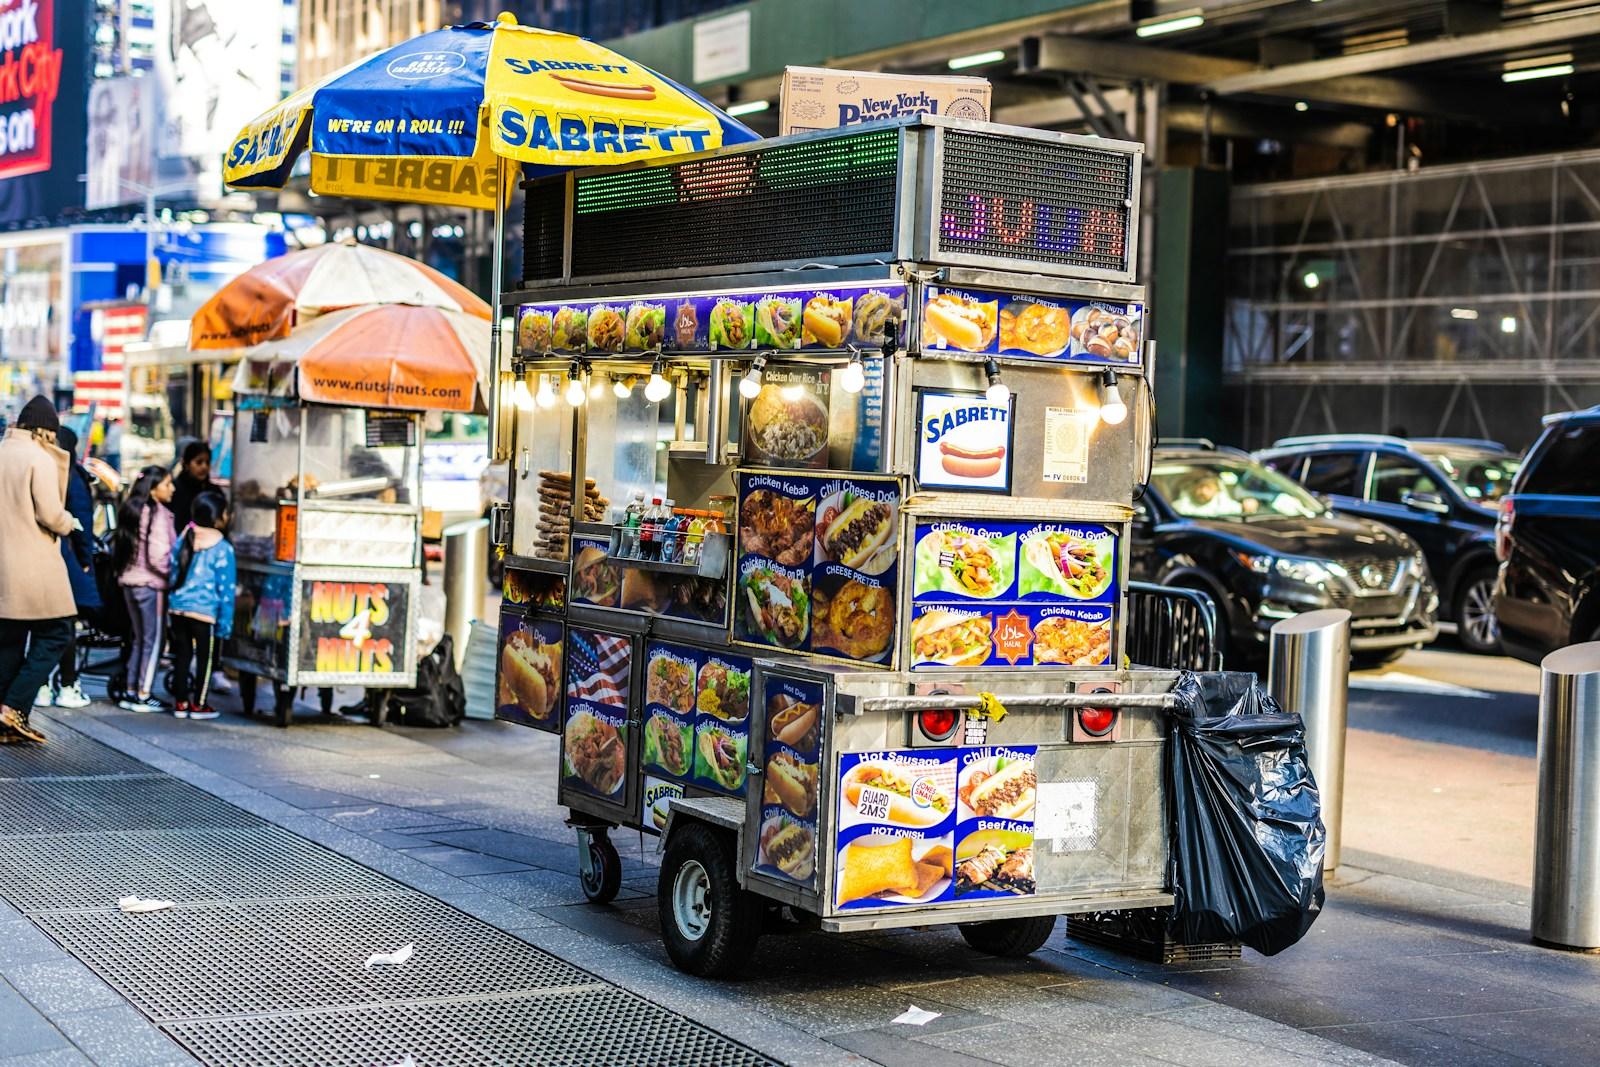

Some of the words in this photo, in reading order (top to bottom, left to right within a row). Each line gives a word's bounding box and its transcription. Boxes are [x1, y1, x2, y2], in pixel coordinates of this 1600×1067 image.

[504, 58, 628, 75] SABRETT
[861, 99, 893, 114] New
[896, 91, 930, 109] York
[328, 118, 372, 133] WE'RE
[374, 119, 395, 133] ON
[397, 119, 406, 133] A
[409, 119, 444, 134] ROLL
[497, 105, 710, 153] SABRETT
[944, 288, 963, 299] Chili
[963, 293, 979, 304] Dog
[1012, 295, 1035, 304] CHEESE
[1036, 298, 1060, 309] PRETZEL
[1089, 300, 1124, 315] CHESTNUTS
[766, 371, 788, 382] Chicken
[788, 372, 802, 383] Over
[803, 374, 815, 384] Rice
[925, 404, 1007, 443] SABRETT
[748, 475, 781, 489] Chicken
[783, 480, 809, 496] Kebab
[820, 479, 841, 498] Chili
[843, 480, 875, 501] Cheese
[877, 489, 895, 502] Dog
[930, 522, 976, 536] Chicken
[977, 528, 1003, 540] Gyro
[1018, 524, 1043, 543] Beef
[1044, 524, 1056, 533] or
[1057, 524, 1083, 538] Lamb
[1085, 530, 1108, 542] Gyro
[741, 556, 766, 574] Chicken
[767, 559, 786, 577] Kebab
[787, 570, 796, 579] on
[825, 565, 852, 579] CHEESE
[853, 573, 882, 589] PRETZEL
[311, 581, 389, 626] NUTS
[921, 605, 949, 614] ITALIAN
[950, 606, 982, 618] SAUSAGE
[1040, 606, 1075, 617] Chicken
[1077, 608, 1104, 620] Kebab
[339, 609, 371, 649] 4
[518, 621, 532, 637] Chili
[534, 629, 547, 646] Dog
[1000, 624, 1025, 640] حلال
[649, 647, 671, 658] Chicken
[1004, 640, 1022, 648] HALAL
[316, 637, 394, 672] NUTS
[783, 683, 794, 694] Hot
[794, 688, 806, 701] Dog
[569, 701, 595, 717] Combo
[595, 709, 609, 722] over
[609, 715, 624, 728] Rice
[652, 708, 674, 723] Chicken
[674, 717, 687, 729] Gyro
[695, 720, 709, 734] Beef
[716, 722, 731, 736] Lamb
[781, 745, 793, 756] Chili
[858, 752, 884, 764] Hot
[887, 751, 940, 767] Sausage
[963, 747, 992, 766] Chili
[646, 784, 682, 808] SABRETT
[862, 789, 889, 806] GUARD
[764, 806, 779, 819] Chili
[780, 808, 802, 826] Cheese
[859, 803, 887, 819] 2MS
[871, 826, 893, 837] HOT
[895, 828, 925, 840] KNISH
[978, 820, 1006, 832] Beef
